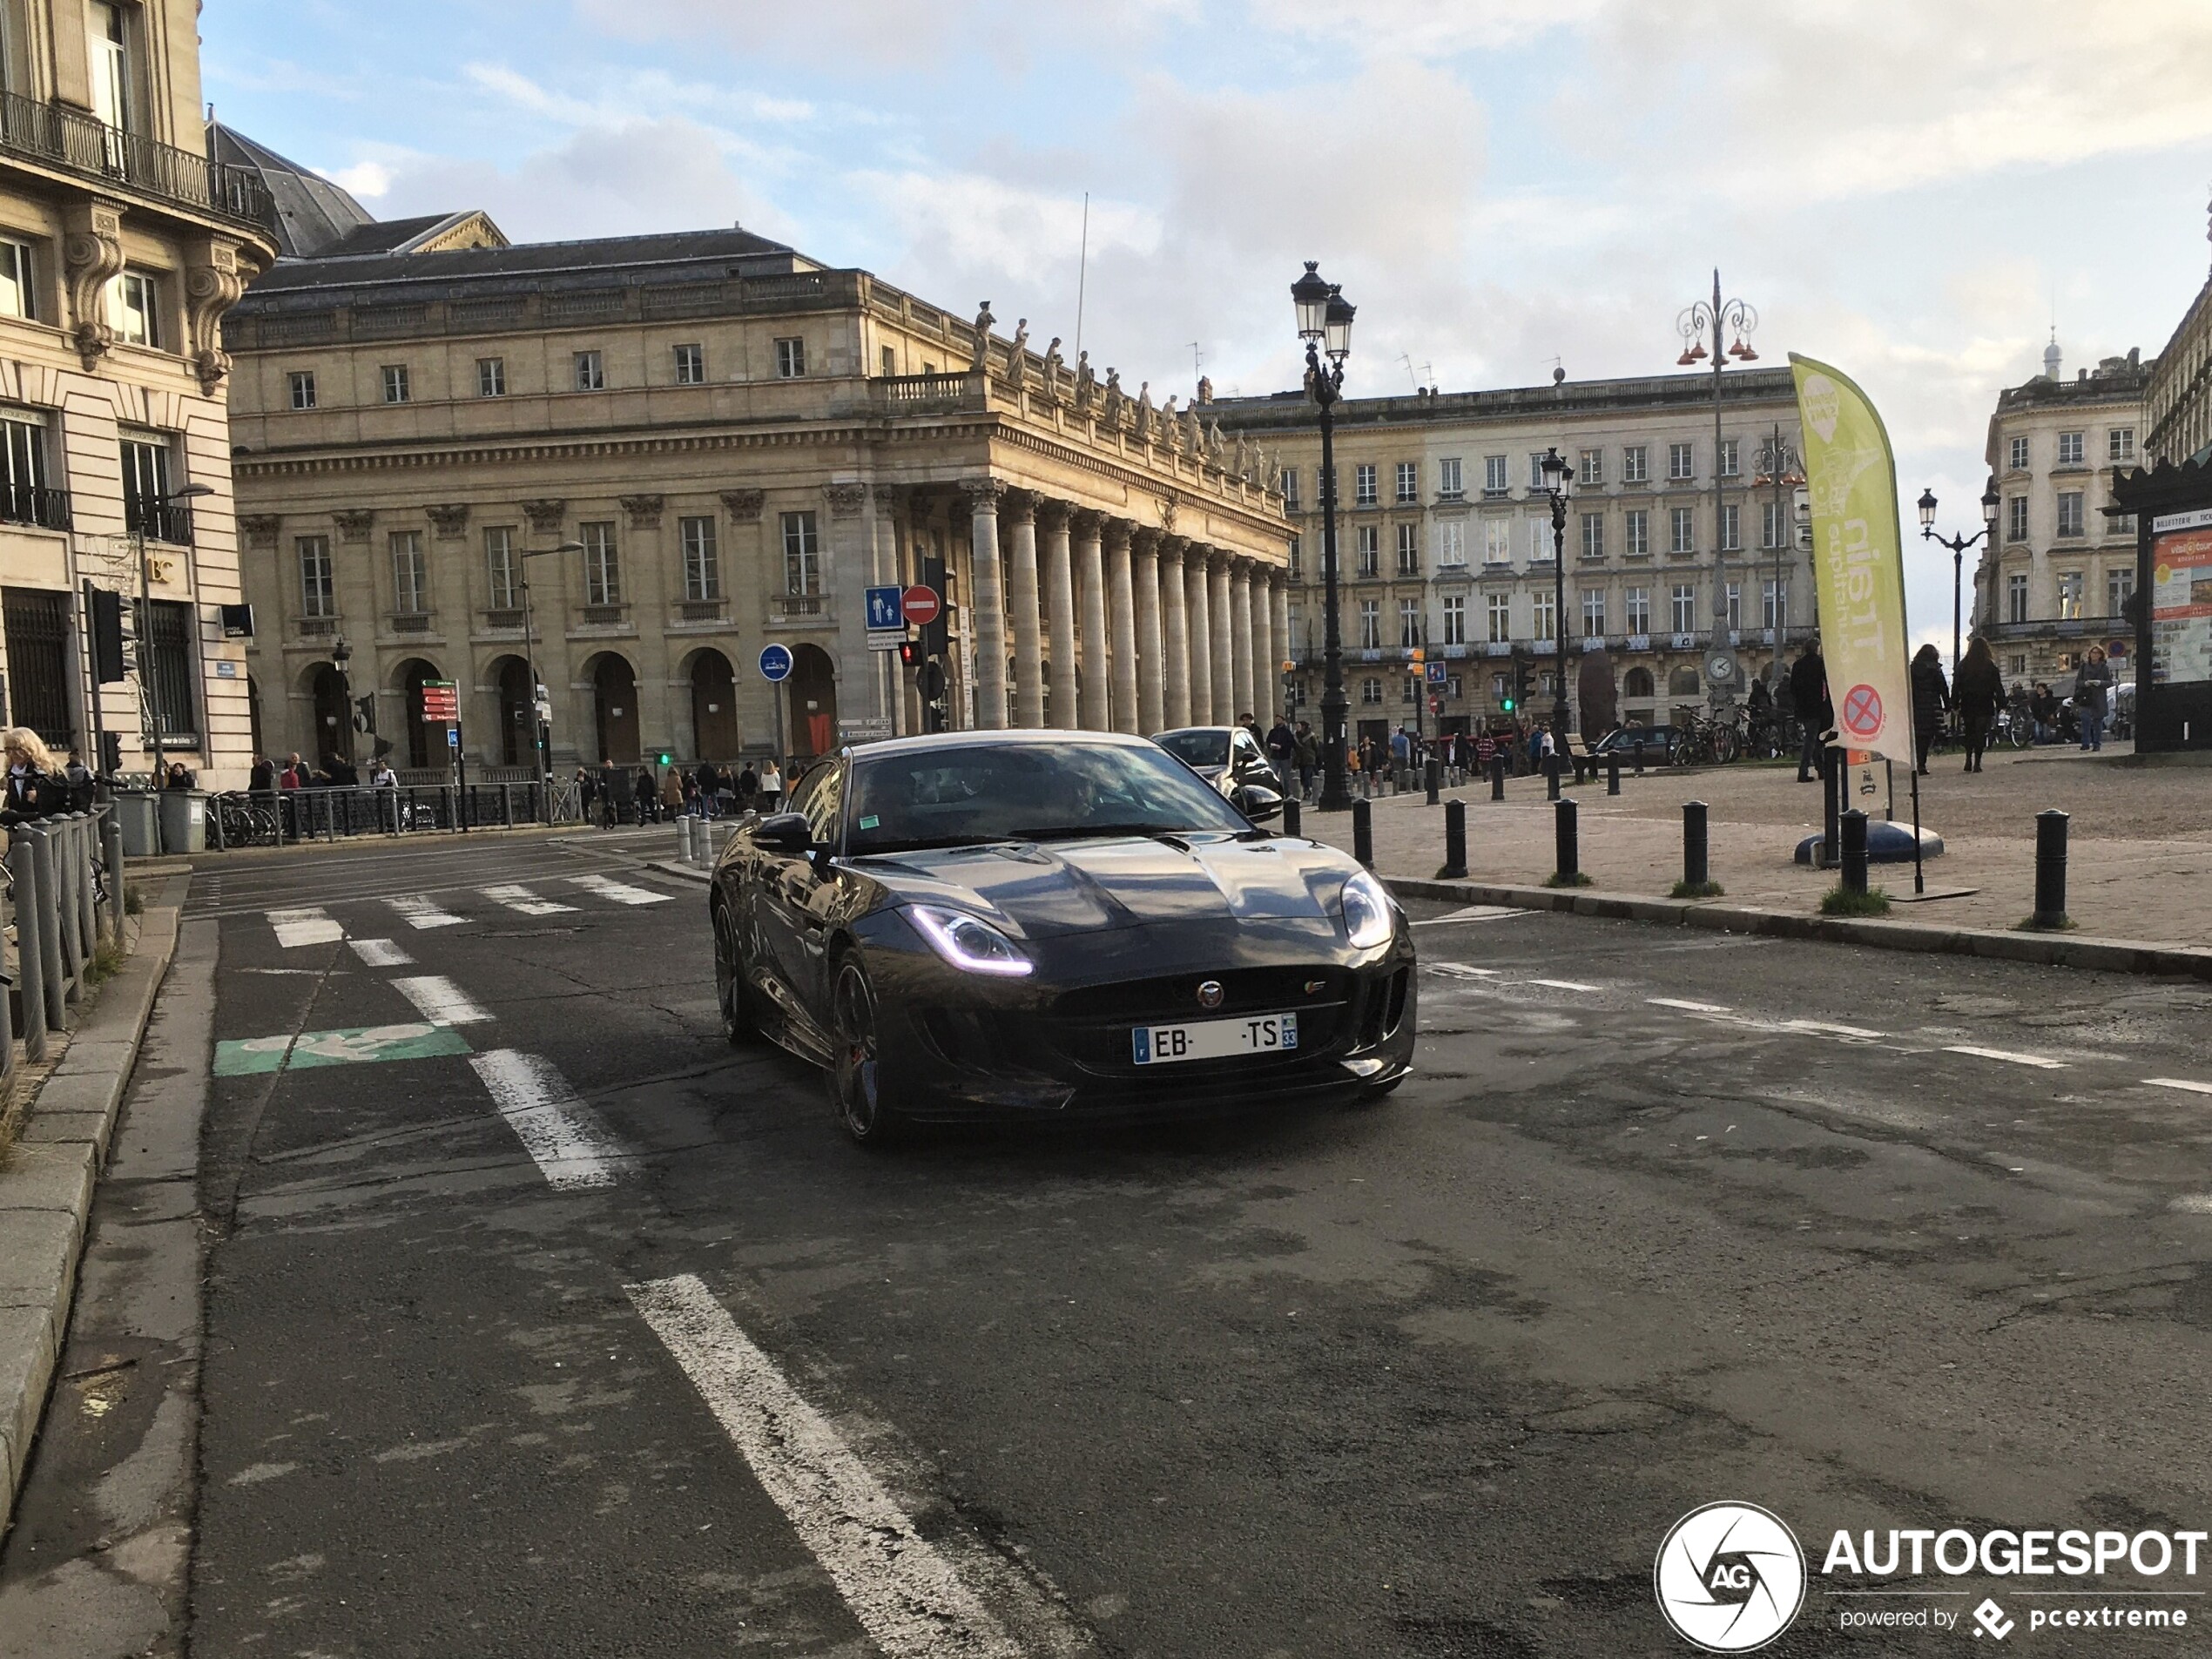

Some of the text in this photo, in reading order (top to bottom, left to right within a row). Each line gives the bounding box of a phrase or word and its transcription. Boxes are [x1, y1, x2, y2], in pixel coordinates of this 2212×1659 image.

[2156, 516, 2191, 528] BILLETTERIE
[1283, 1031, 1296, 1045] 33
[1139, 1049, 1145, 1057] F
